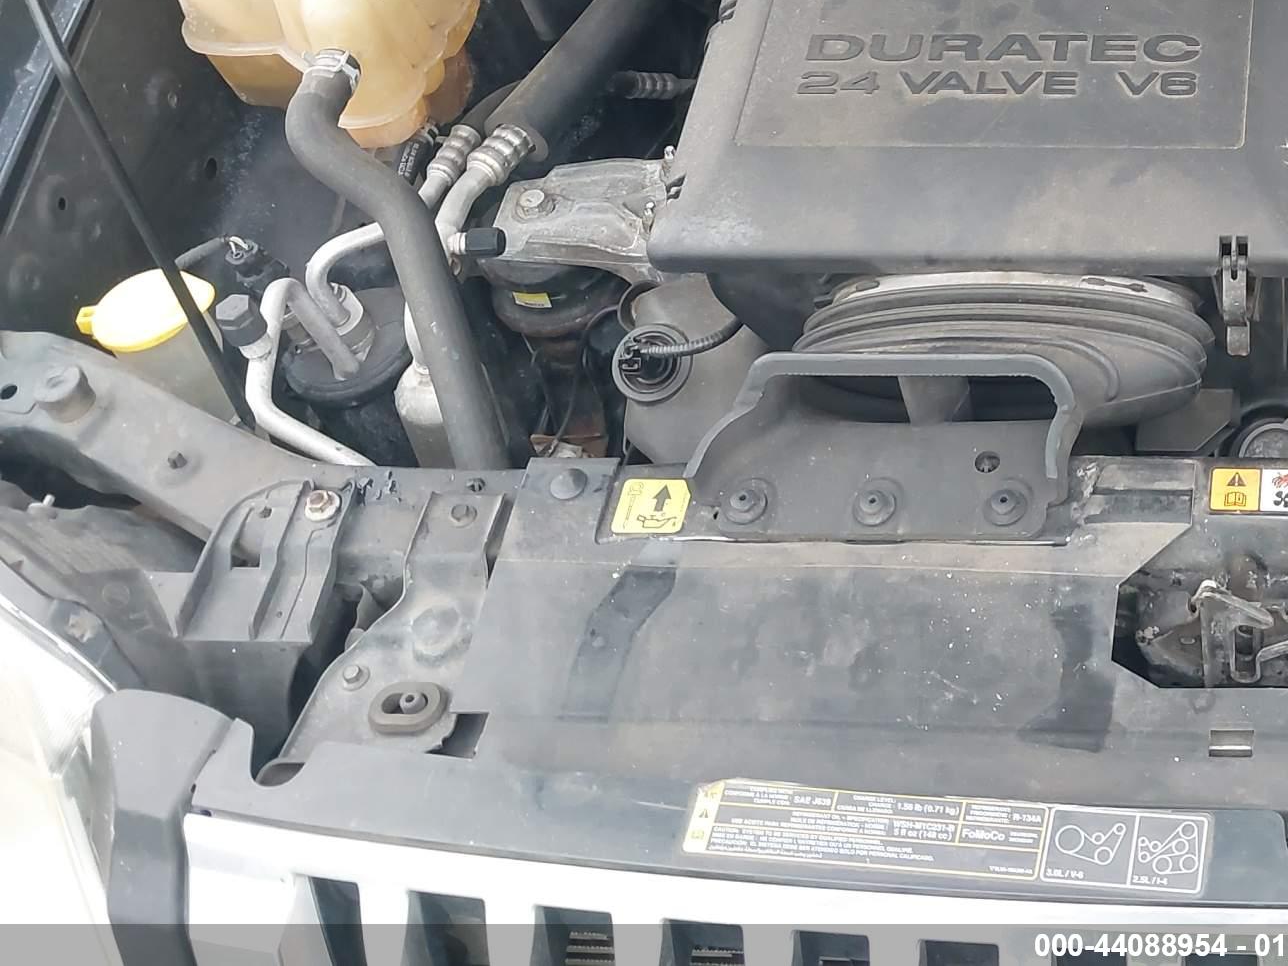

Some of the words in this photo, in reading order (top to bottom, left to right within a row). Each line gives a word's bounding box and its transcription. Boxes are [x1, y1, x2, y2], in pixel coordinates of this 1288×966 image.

[805, 33, 1200, 62] DURATEC
[797, 71, 880, 96] 24
[900, 71, 1079, 96] VALVE
[1118, 71, 1199, 97] V6
[793, 795, 812, 805] SAE
[945, 805, 960, 816] kg)
[961, 828, 1006, 842] FoMoCo
